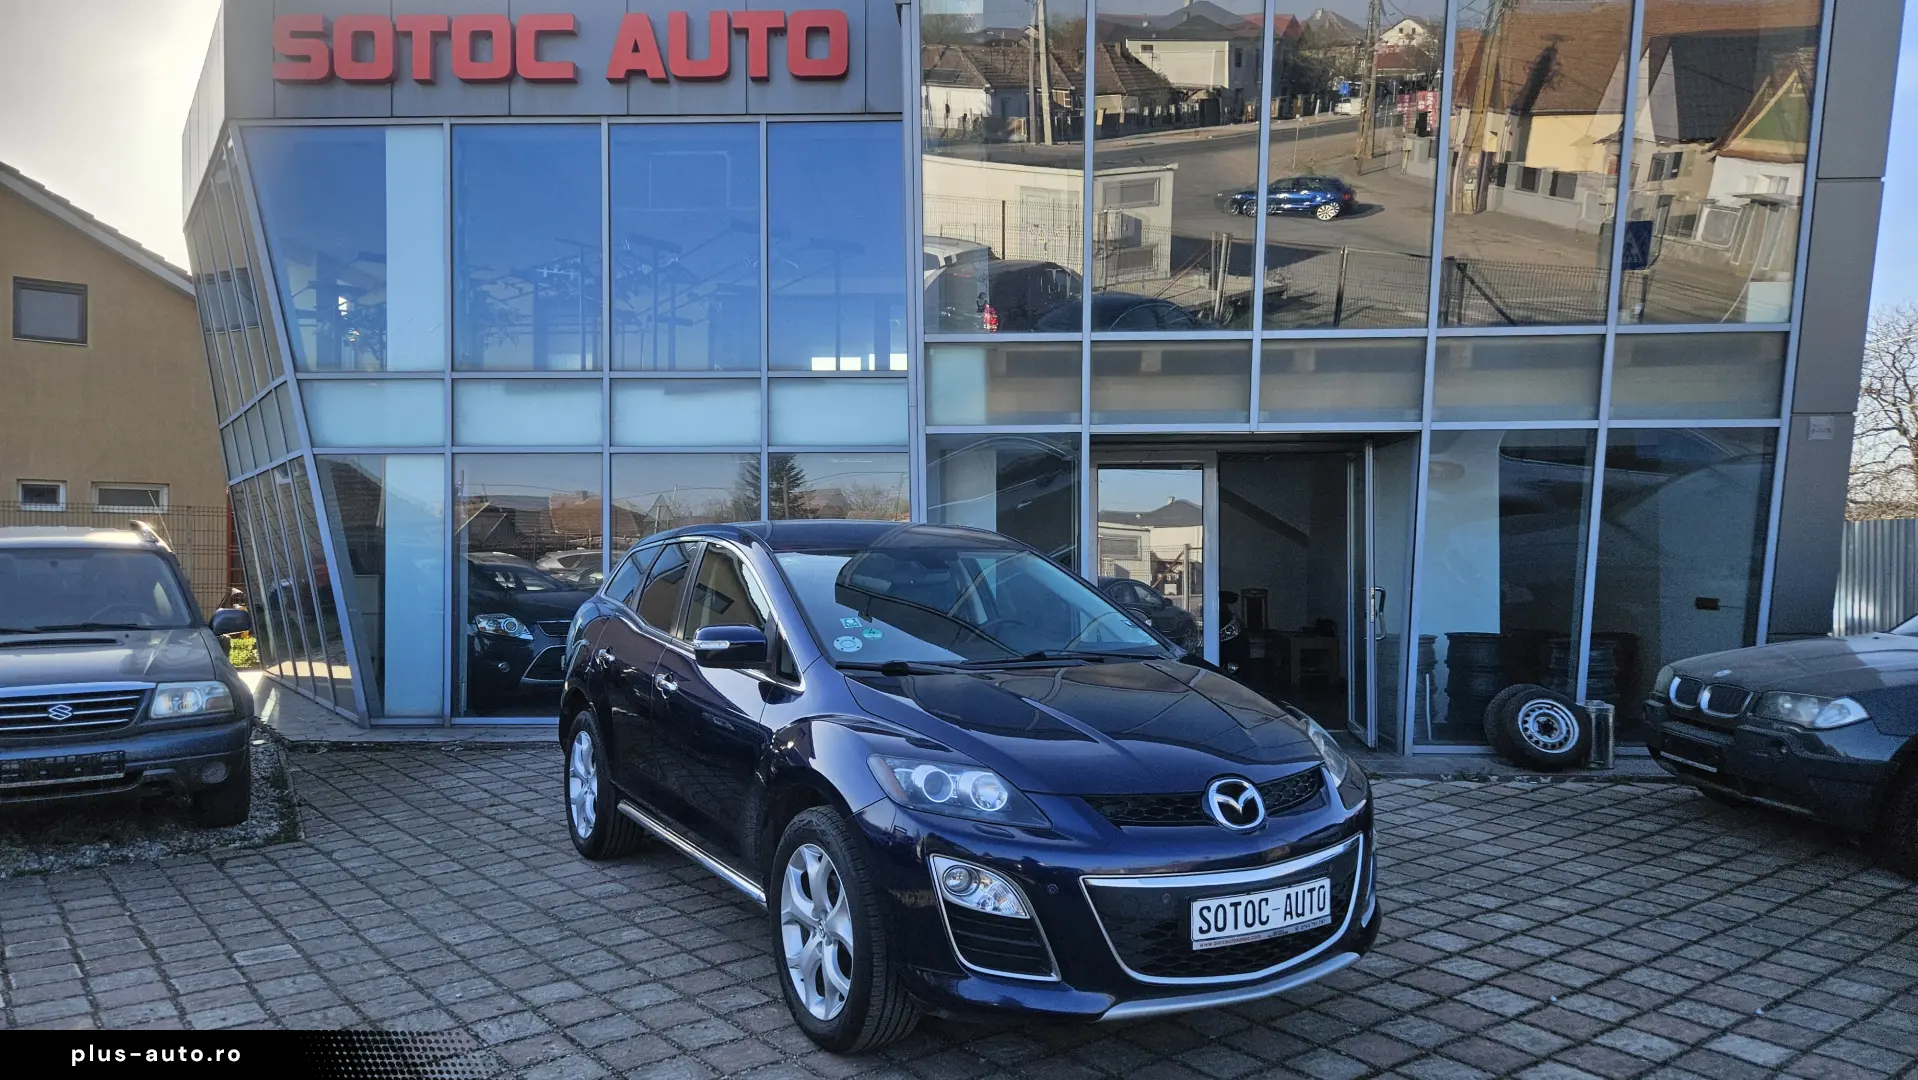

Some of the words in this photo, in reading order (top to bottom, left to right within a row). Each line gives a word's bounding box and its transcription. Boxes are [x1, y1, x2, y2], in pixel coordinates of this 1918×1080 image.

[272, 13, 578, 85] SOTOC
[606, 10, 850, 84] AUTO
[1198, 885, 1326, 934] SOTOC-AUTO
